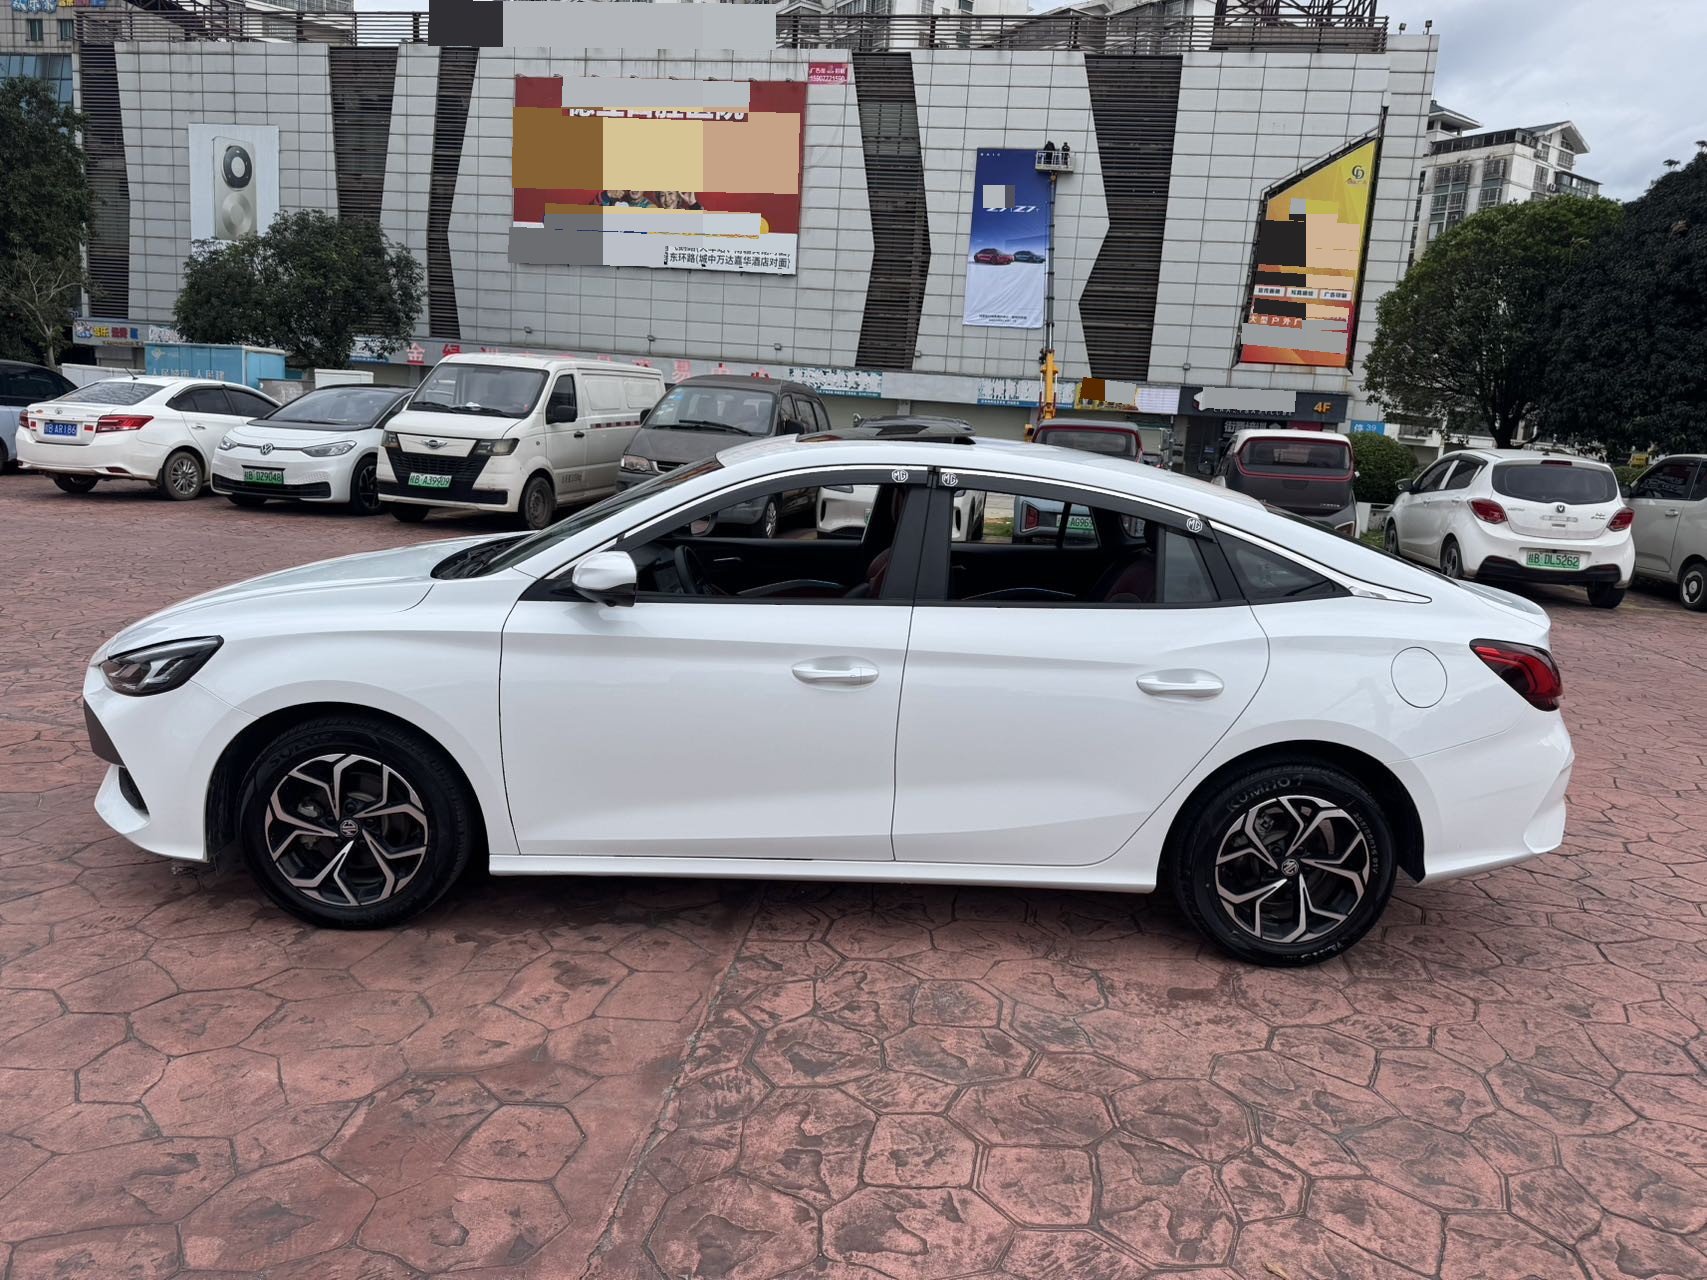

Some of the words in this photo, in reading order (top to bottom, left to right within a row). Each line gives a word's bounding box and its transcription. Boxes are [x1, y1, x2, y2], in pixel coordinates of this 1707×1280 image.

[669, 252, 791, 269] 东环路(城中万达嘉华酒店对面)
[1313, 401, 1333, 415] 4F
[1544, 553, 1580, 567] DL5262
